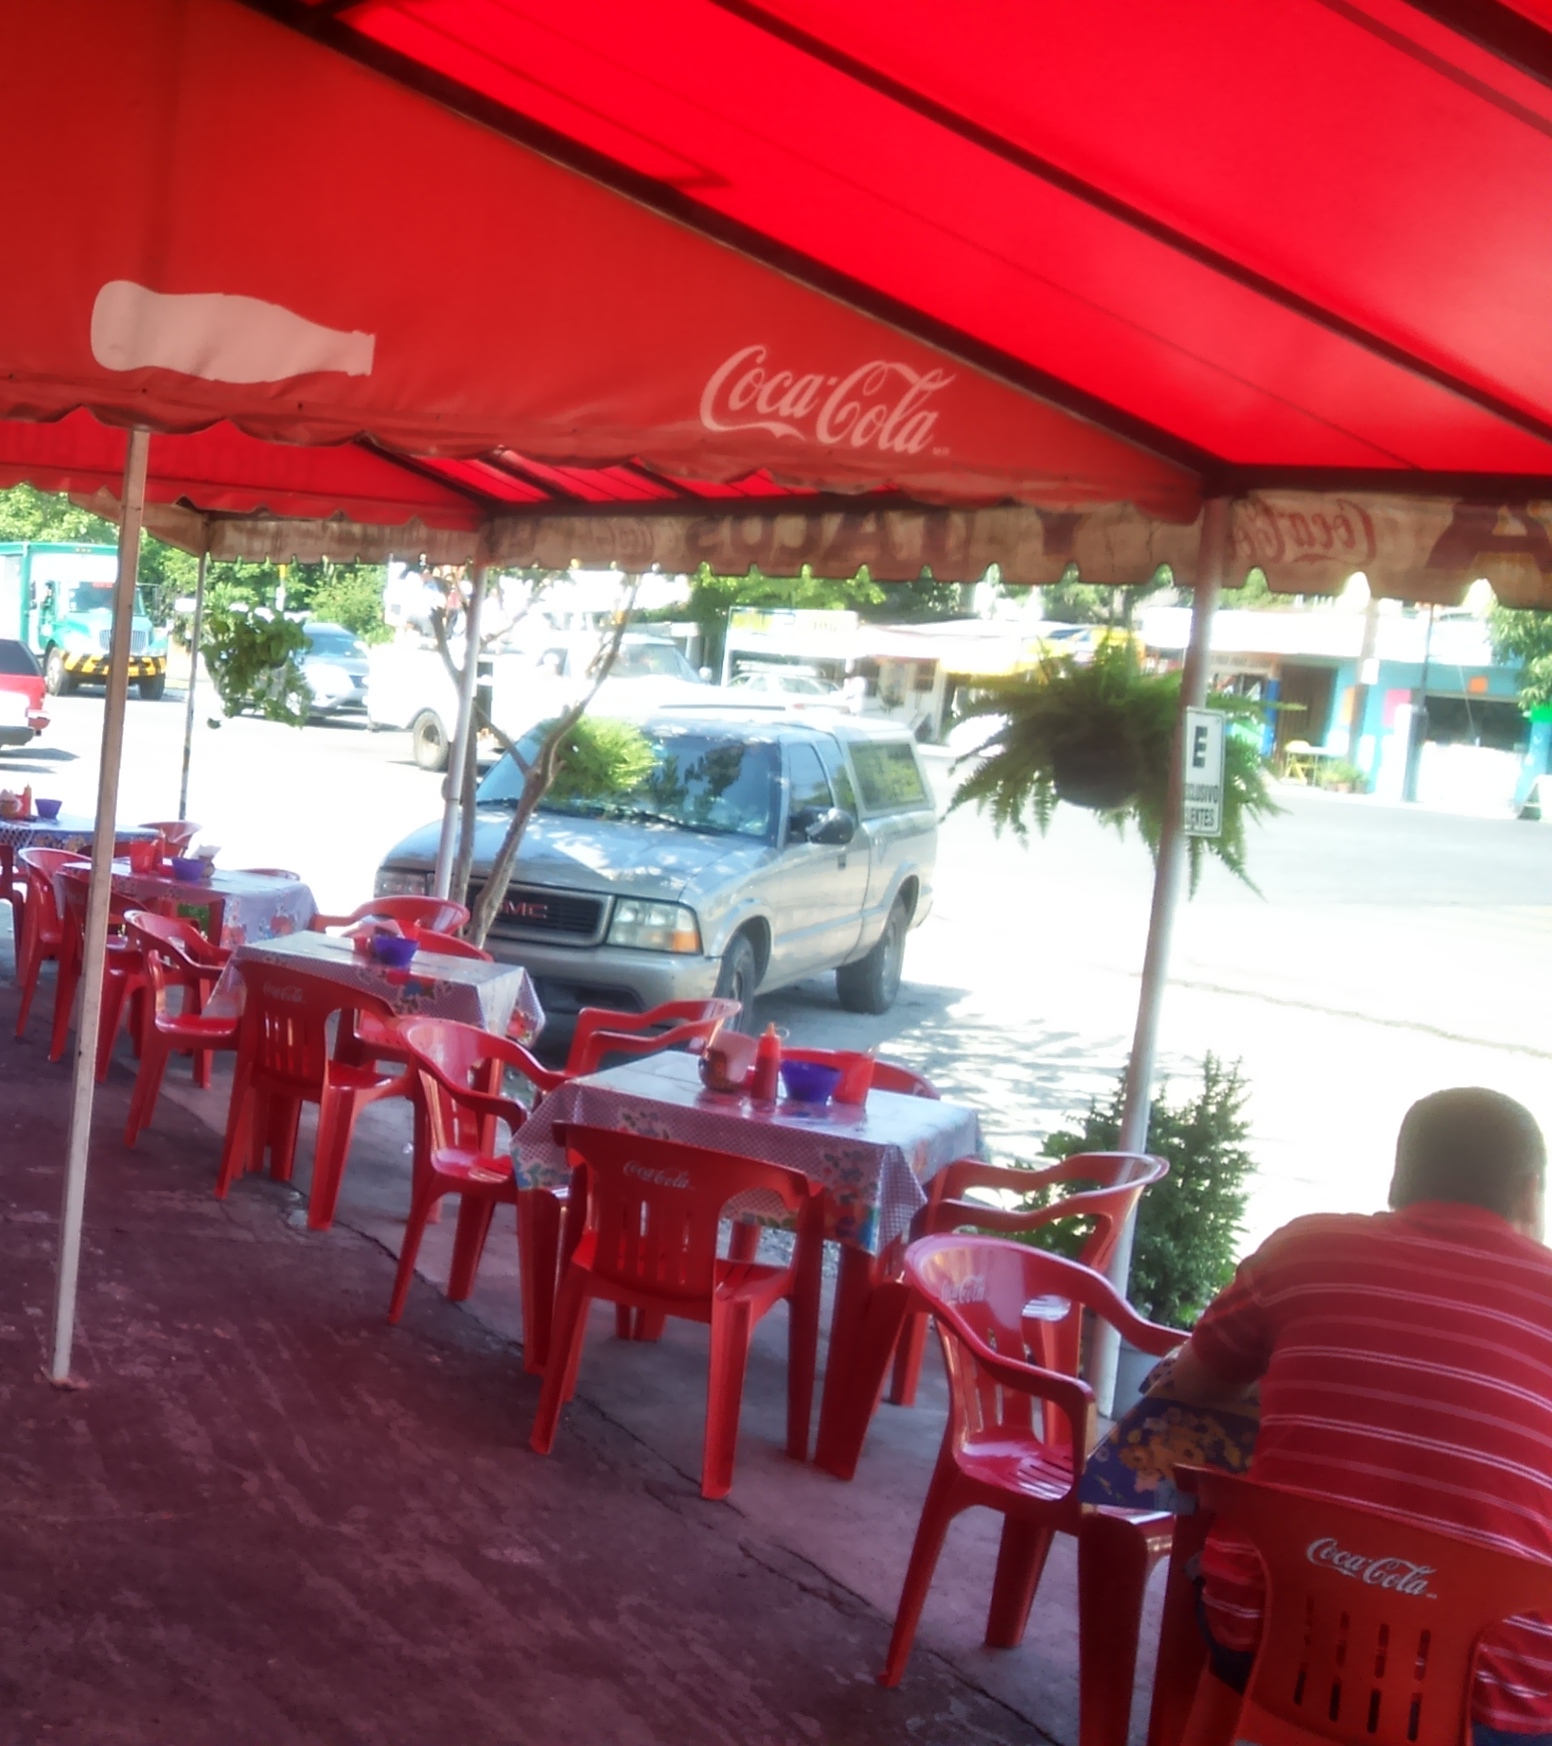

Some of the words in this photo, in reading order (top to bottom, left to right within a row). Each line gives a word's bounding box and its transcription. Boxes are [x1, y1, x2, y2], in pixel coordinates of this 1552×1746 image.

[700, 344, 956, 454] Coca-Cola
[1193, 726, 1208, 768] E
[501, 901, 548, 919] MC
[1306, 1537, 1437, 1595] Coca-Cola
